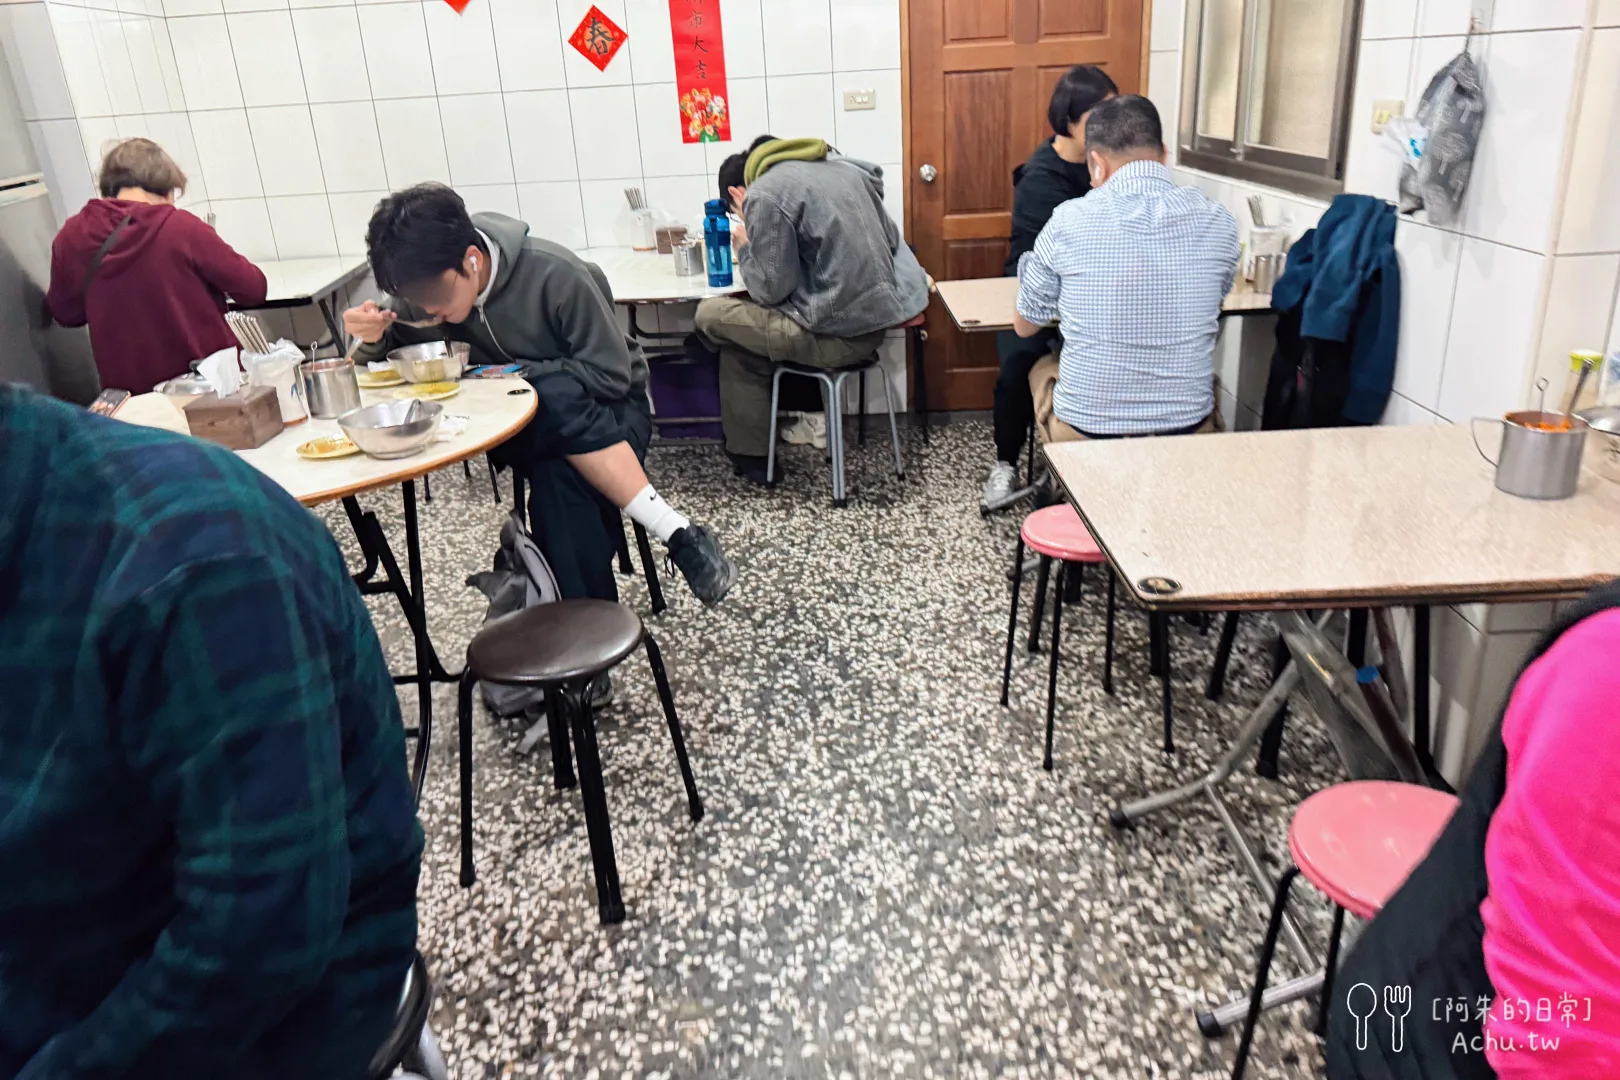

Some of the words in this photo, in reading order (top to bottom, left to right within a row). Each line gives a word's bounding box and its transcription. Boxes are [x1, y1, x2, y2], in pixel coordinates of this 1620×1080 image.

[586, 16, 616, 56] 春
[684, 0, 709, 79] 市大吉
